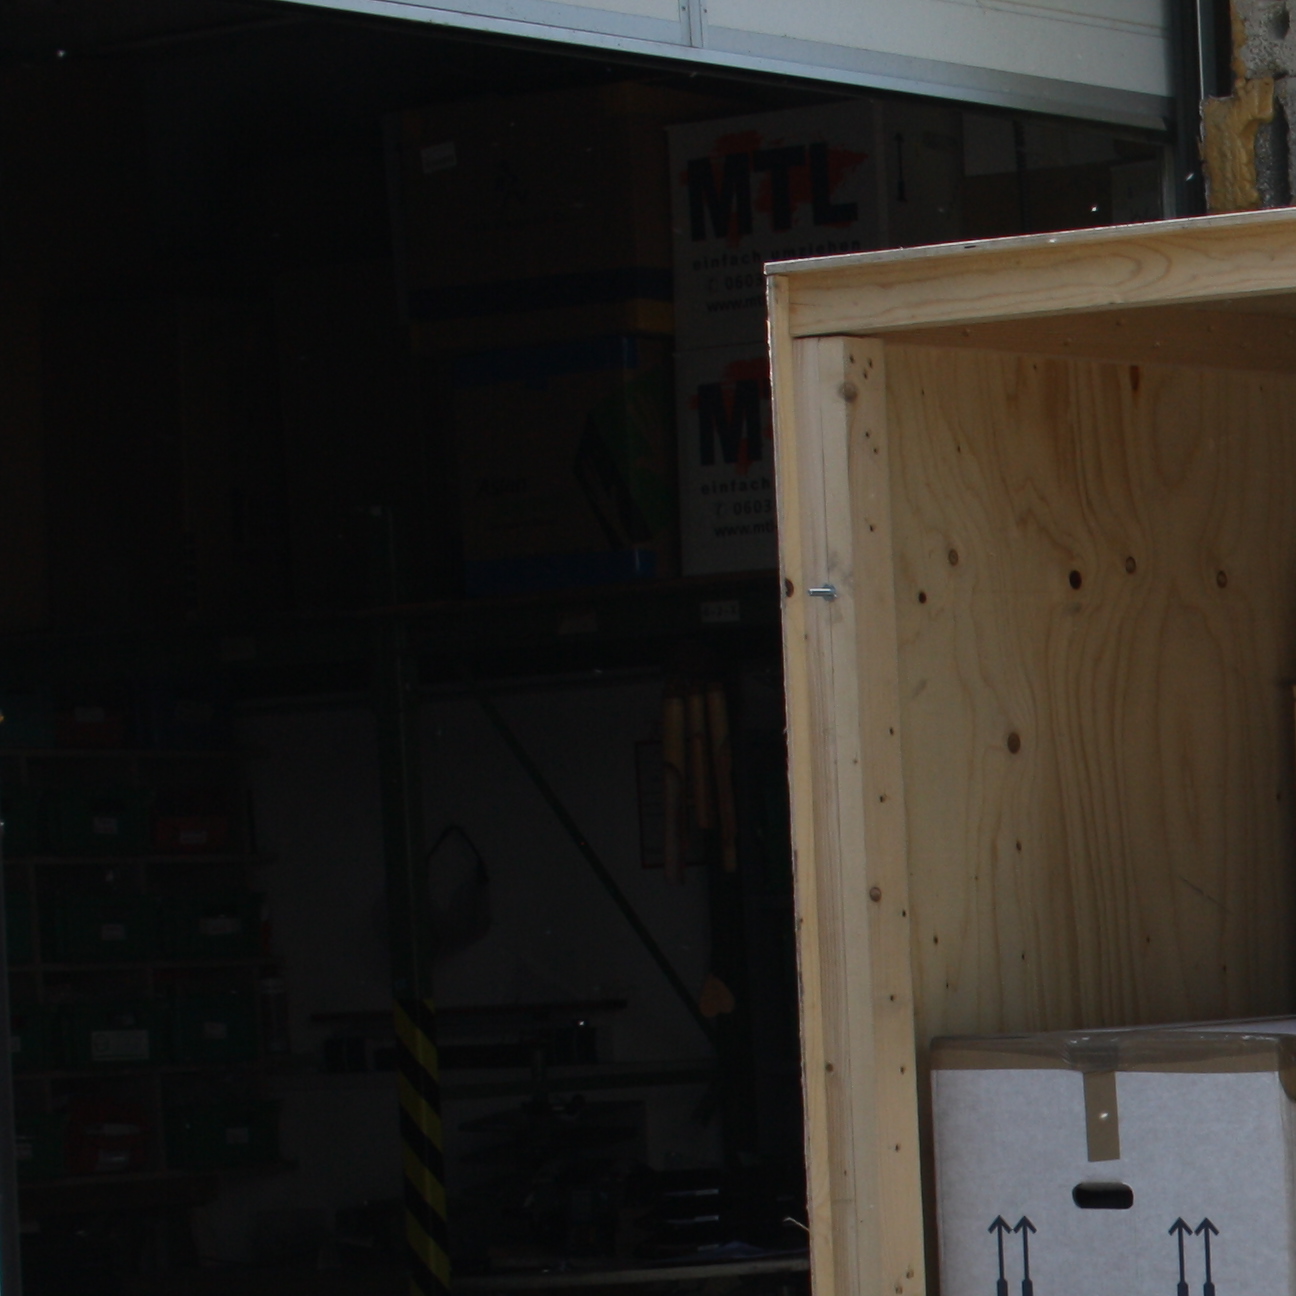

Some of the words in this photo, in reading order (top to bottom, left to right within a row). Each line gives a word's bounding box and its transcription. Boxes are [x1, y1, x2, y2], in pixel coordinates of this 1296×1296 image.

[687, 142, 859, 241] MTL
[693, 245, 762, 271] einfach
[706, 295, 765, 314] www.mt
[698, 378, 771, 466] M
[701, 477, 771, 495] einfach
